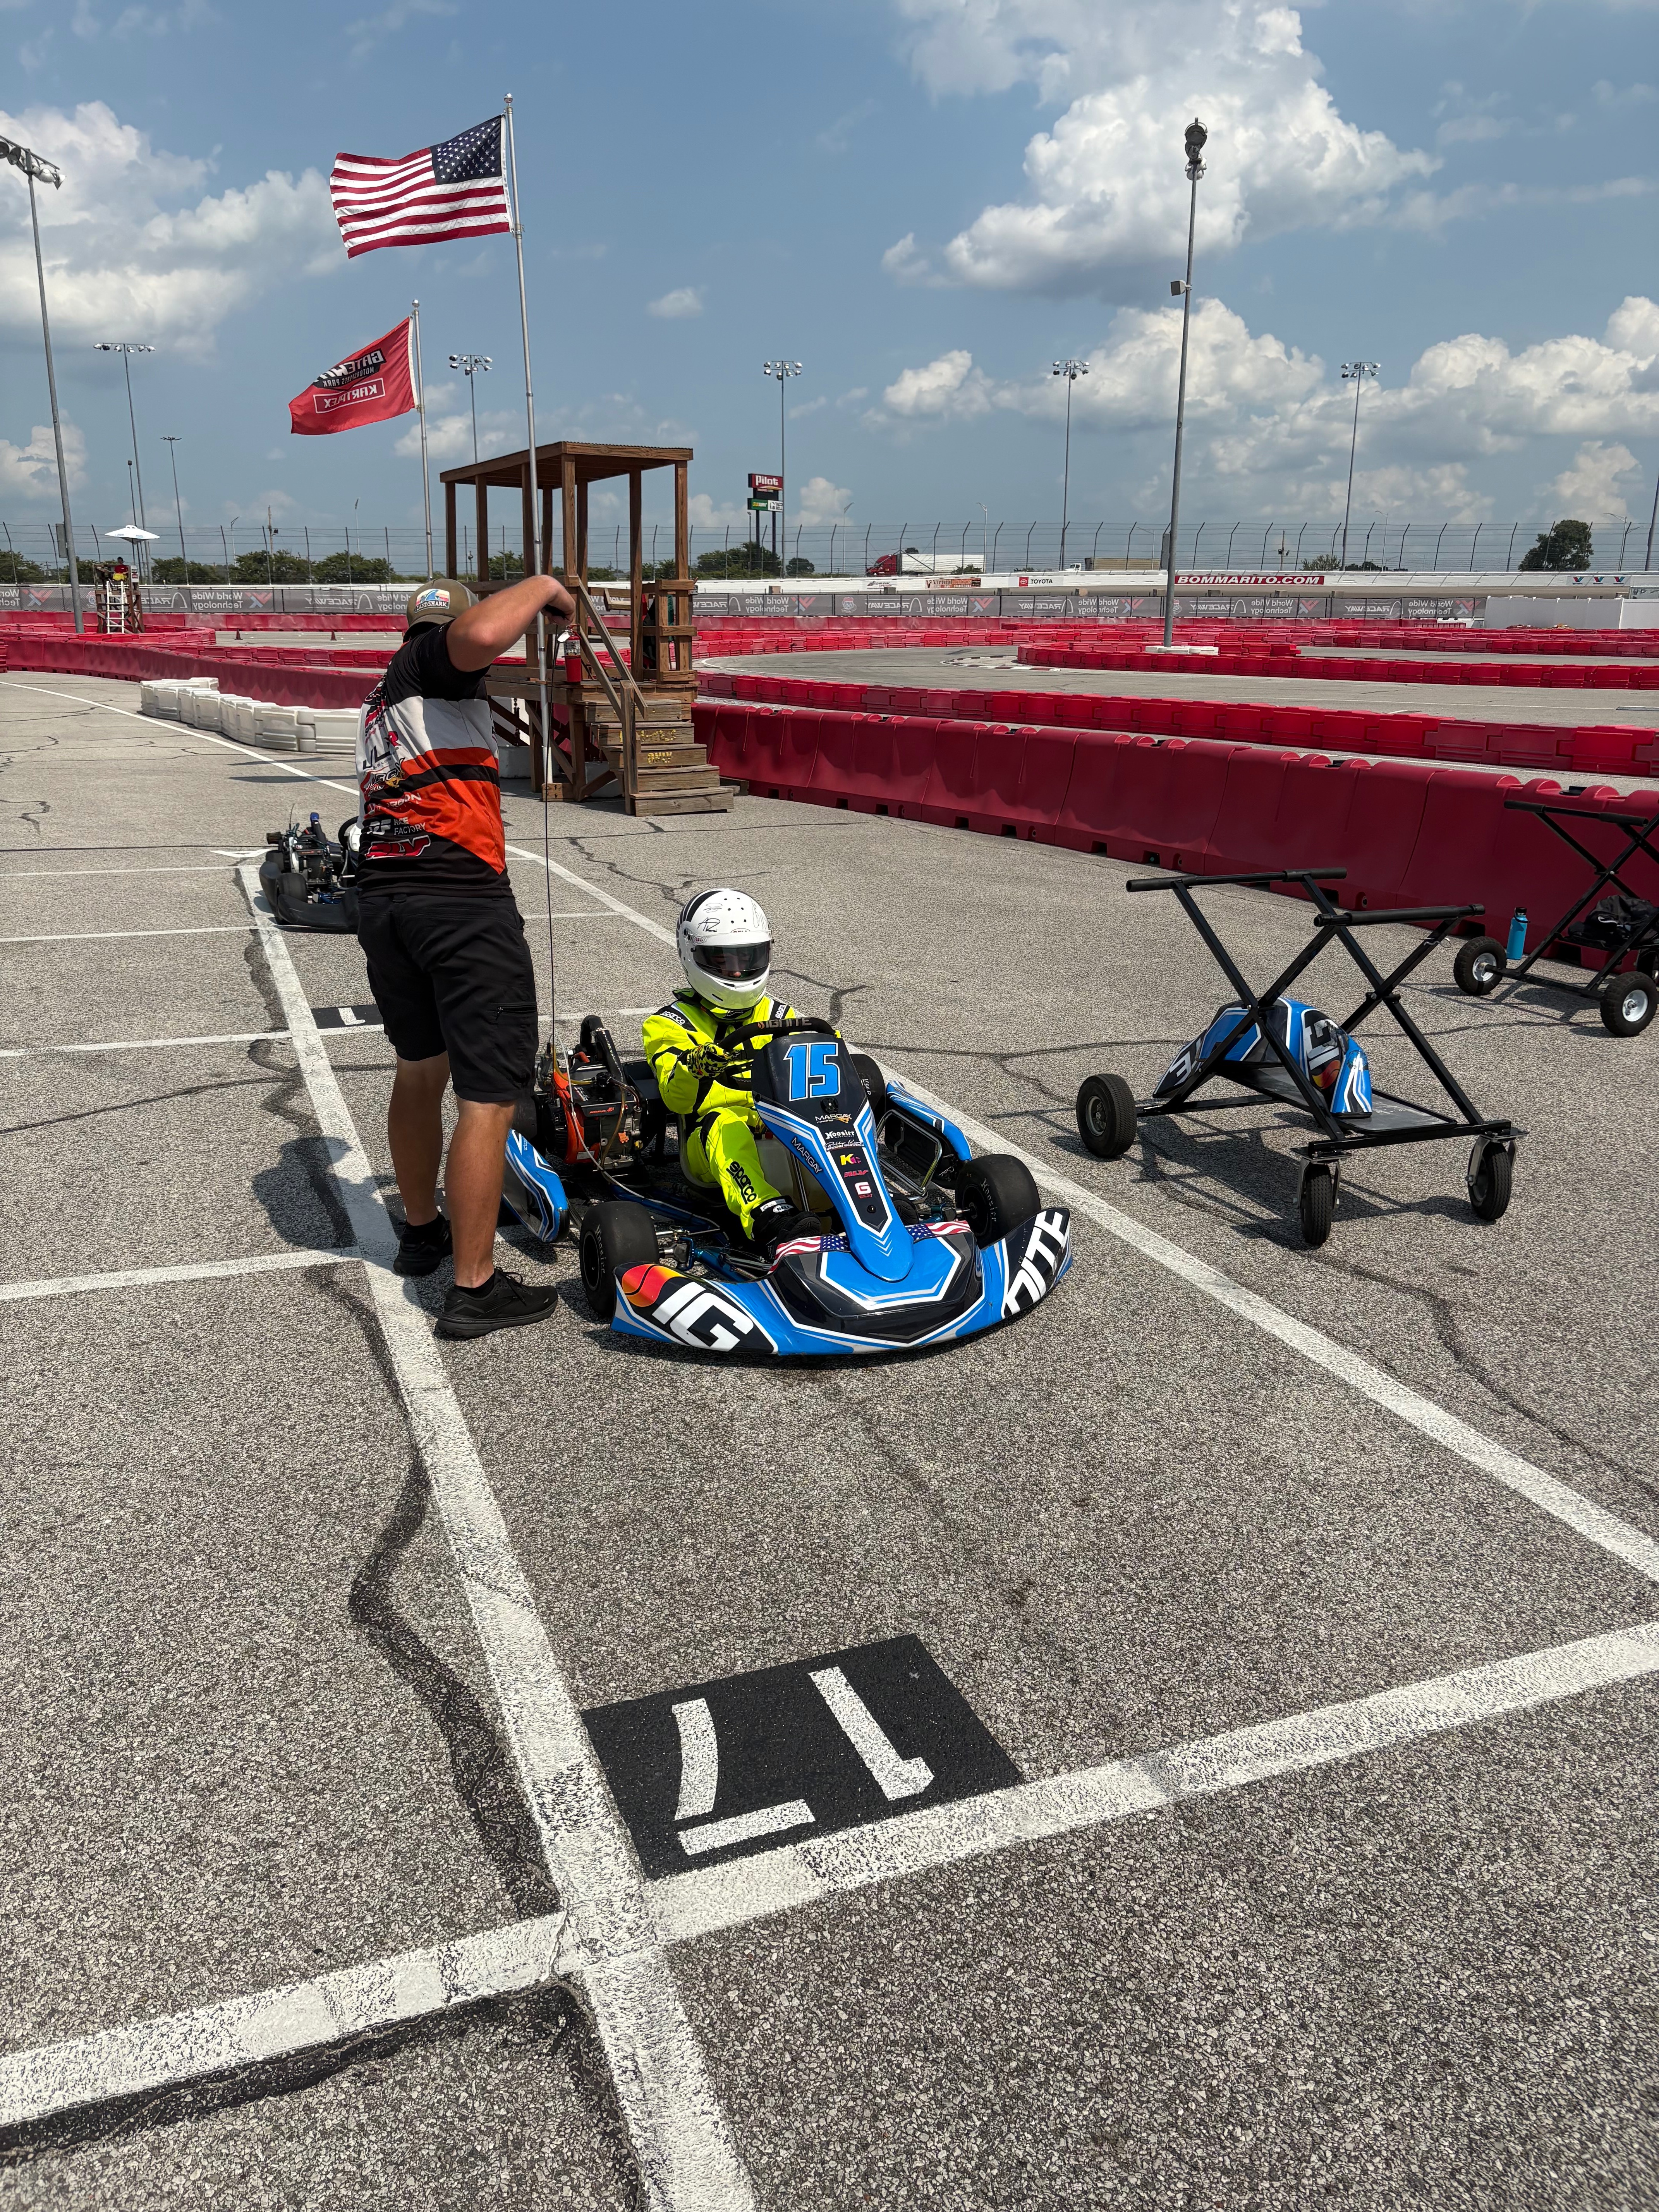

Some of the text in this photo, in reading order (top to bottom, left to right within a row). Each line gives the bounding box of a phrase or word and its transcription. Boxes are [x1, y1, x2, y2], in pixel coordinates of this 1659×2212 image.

[756, 475, 778, 486] Pilot
[1178, 576, 1321, 584] BOMMARITO.COM
[416, 601, 448, 610] LANDSHARK
[394, 822, 426, 835] FACTORY
[766, 1017, 812, 1028] IGNITE
[783, 1042, 841, 1102] 15
[792, 1137, 823, 1174] MARGAY
[726, 1161, 757, 1205] sparco
[671, 1666, 935, 1856] 17
